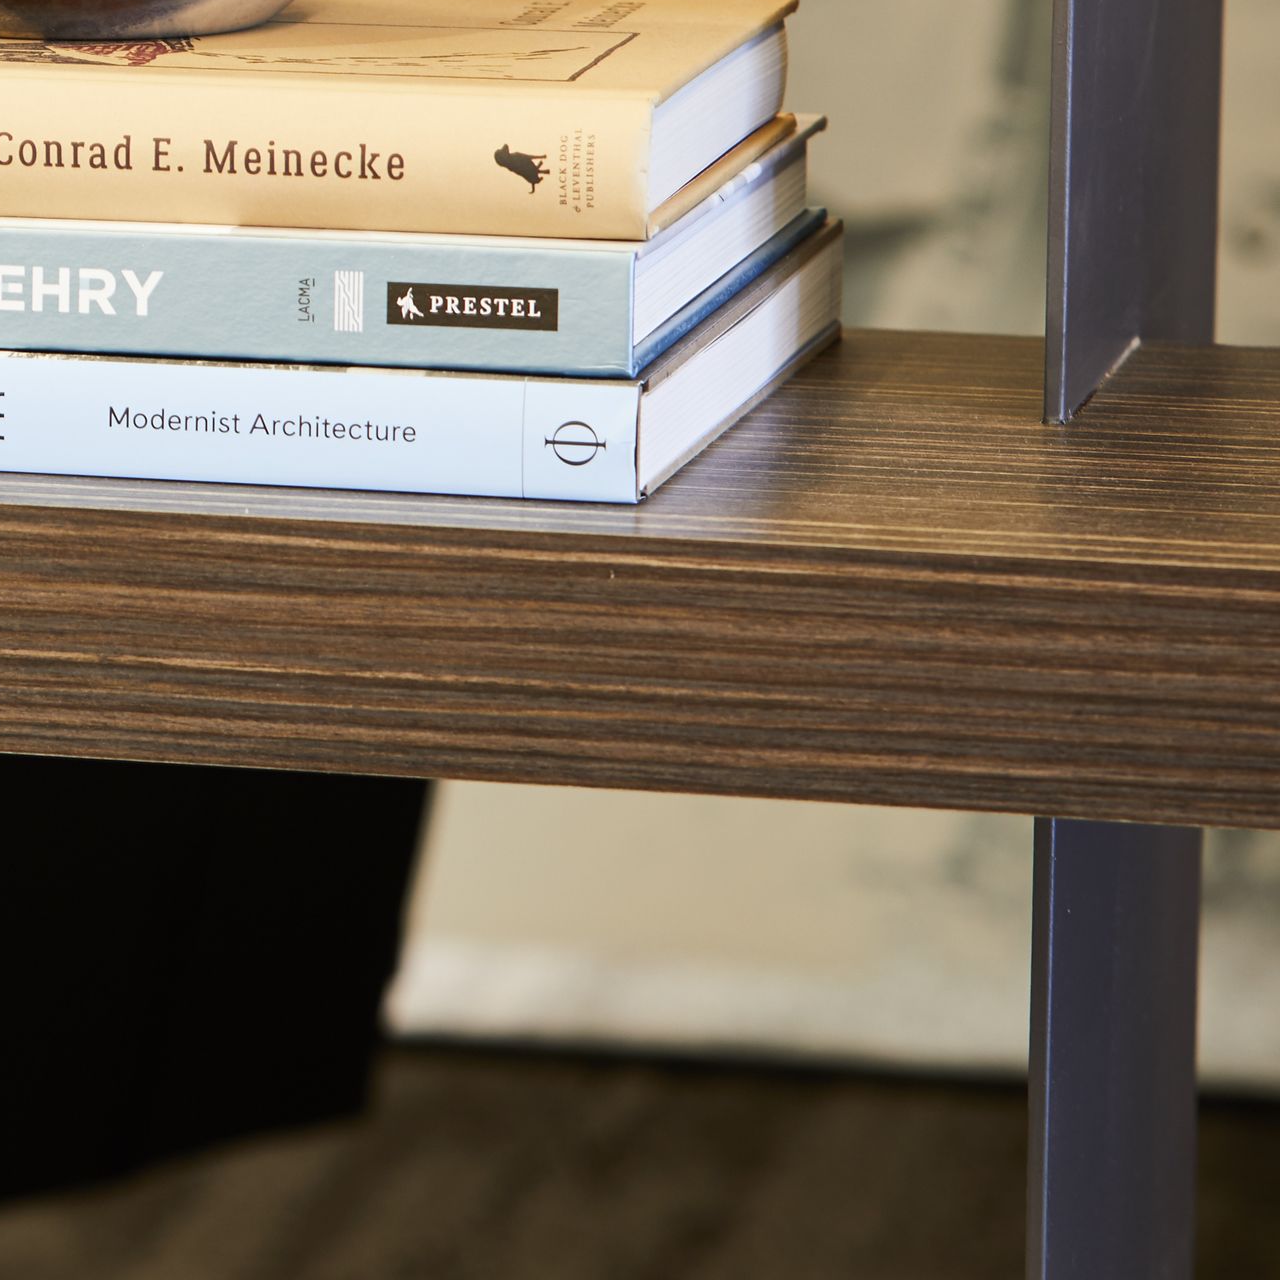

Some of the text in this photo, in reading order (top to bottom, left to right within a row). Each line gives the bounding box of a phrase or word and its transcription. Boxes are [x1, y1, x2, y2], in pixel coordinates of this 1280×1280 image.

[152, 137, 185, 174] E.
[202, 138, 407, 181] Meinecke
[559, 135, 569, 205] BLACK DOG
[572, 128, 583, 201] LEVENTHAL
[586, 134, 596, 208] PUBLISHERS
[297, 277, 314, 323] LACMA
[429, 294, 542, 318] PRESTEL
[108, 405, 418, 444] Modernist Architecture
